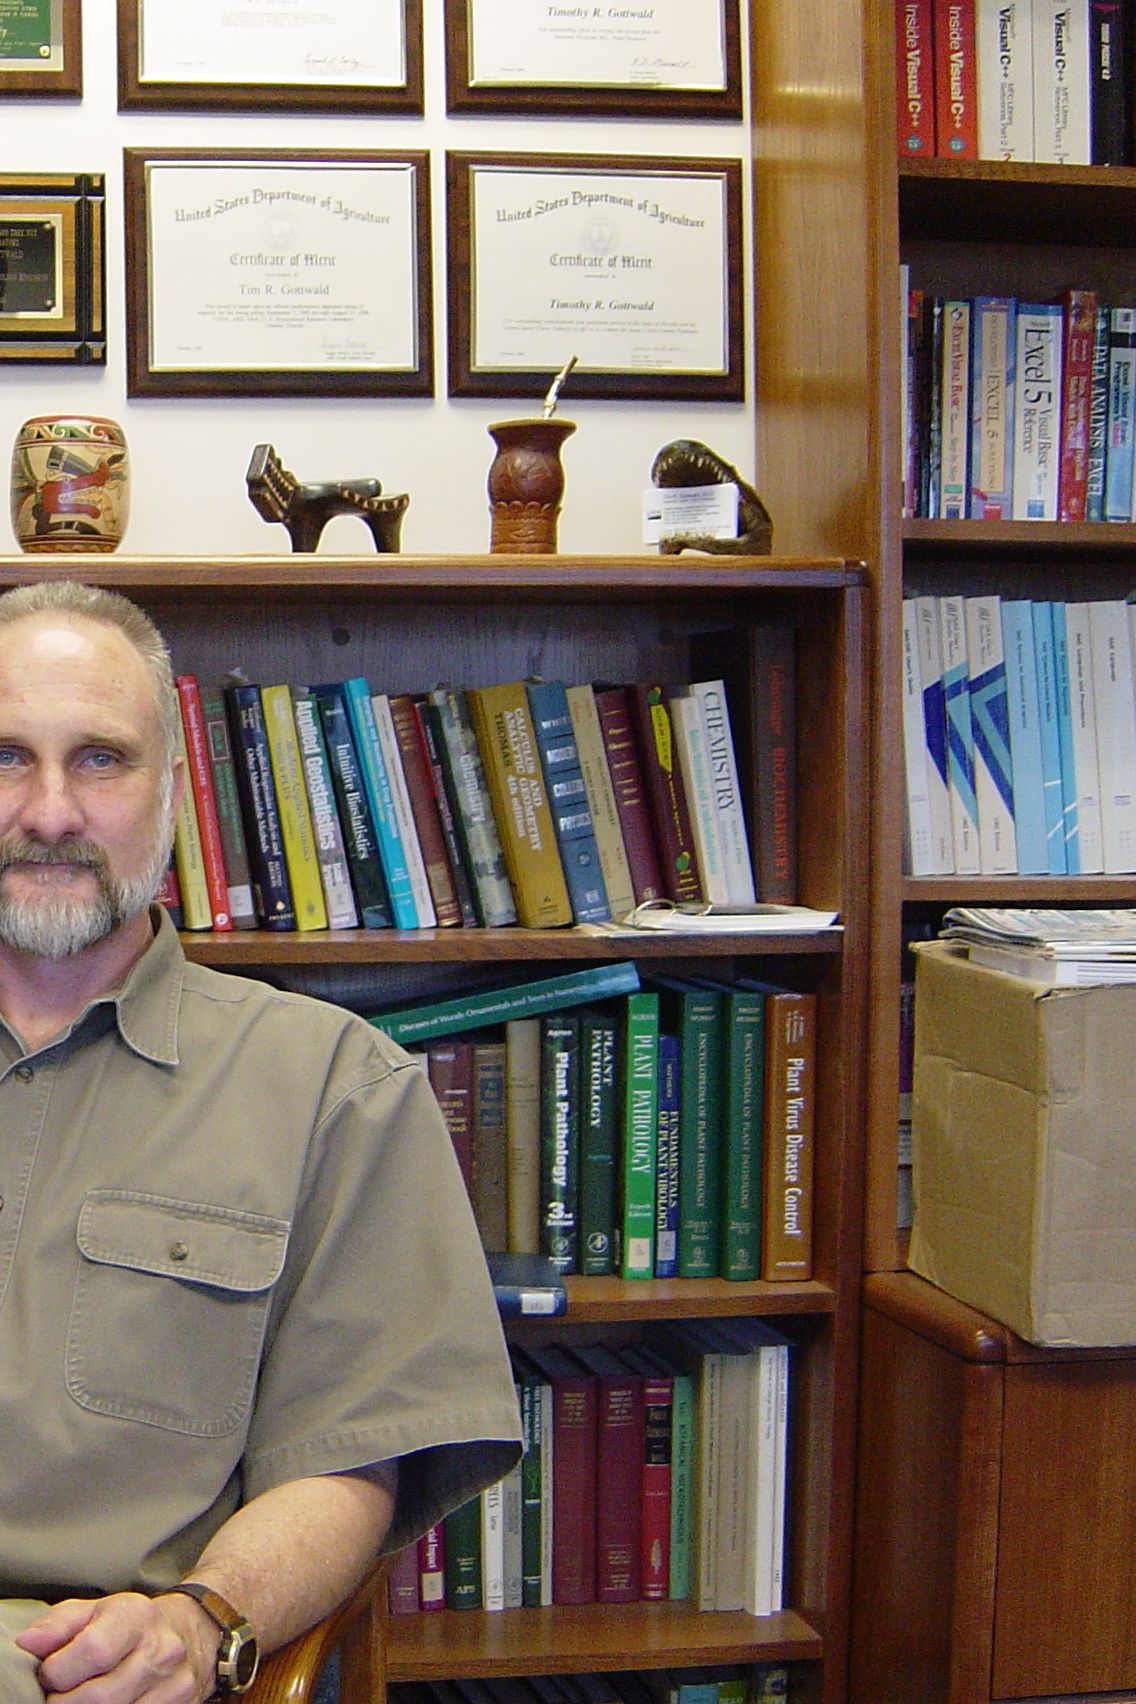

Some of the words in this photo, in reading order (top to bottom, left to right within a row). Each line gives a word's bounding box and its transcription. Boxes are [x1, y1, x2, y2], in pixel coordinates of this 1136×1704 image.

[546, 6, 588, 19] Timothy
[592, 6, 604, 19] R.
[607, 6, 654, 19] Gottwald
[905, 4, 920, 48] Inside
[949, 6, 964, 50] Inside
[999, 7, 1011, 52] Visual
[1055, 12, 1066, 55] Visual
[906, 49, 921, 99] Visual
[950, 51, 964, 102] Visual
[1000, 55, 1011, 79] C++
[1055, 58, 1066, 83] C++
[908, 101, 921, 127] C++
[951, 103, 964, 129] C++
[175, 207, 211, 222] United
[214, 196, 249, 215] States
[252, 188, 316, 205] Department
[320, 196, 332, 210] of
[333, 200, 391, 224] Agriculture
[496, 207, 531, 222] United
[535, 197, 569, 216] States
[571, 190, 634, 207] Department
[638, 200, 649, 213] of
[649, 203, 705, 228] Agriculture
[230, 253, 285, 267] Certificate
[290, 253, 300, 267] of
[304, 253, 336, 267] Merit
[549, 253, 604, 268] Certificate
[608, 255, 619, 268] of
[622, 255, 652, 269] Merit
[239, 284, 260, 296] Tim
[265, 284, 276, 296] R.
[281, 284, 329, 296] Gottwald
[549, 299, 591, 311] Timothy
[594, 299, 605, 311] R.
[608, 299, 654, 311] Gottwald
[1023, 328, 1052, 384] Excel
[1093, 345, 1107, 380] DATA
[986, 374, 1000, 426] EXCEL
[1024, 388, 1052, 404] 5
[1090, 384, 1105, 449] ANALYSIS
[1023, 407, 1037, 453] Reference
[1038, 407, 1052, 441] Visual
[1037, 442, 1051, 466] Basic
[1087, 457, 1104, 497] EXCEL
[295, 700, 320, 755] Applied
[255, 742, 268, 770] Applied
[514, 707, 537, 774] CALCULUS
[530, 778, 544, 807] AND
[703, 691, 735, 811] CHEMISTRY
[495, 712, 512, 767] THOMAS
[507, 774, 517, 795] 4th
[513, 798, 526, 838] edition
[504, 710, 525, 773] ANALYTIC
[519, 777, 541, 851] GEOMETRY
[306, 757, 336, 850] Geostatistics
[337, 743, 355, 791] Intuitive
[346, 792, 371, 860] Biostatistics
[547, 1029, 572, 1037] Agrios
[555, 1051, 570, 1096] Plant
[590, 1029, 602, 1128] PATHOLOGY
[603, 1030, 614, 1086] PLANT
[633, 1034, 653, 1079] PLANT
[697, 1032, 707, 1104] ENCYCLOPEDIA
[744, 1033, 753, 1104] ENCYCLOPEDIA
[786, 1057, 804, 1093] Plant
[631, 1089, 651, 1174] PATHOLOGY
[658, 1110, 668, 1129] OF
[698, 1105, 706, 1118] OF
[743, 1106, 752, 1118] OF
[786, 1097, 804, 1130] Virus
[552, 1101, 570, 1187] Pathology
[657, 1130, 668, 1168] PLANT
[698, 1120, 706, 1151] PLANT
[742, 1121, 752, 1152] PLANT
[668, 1110, 679, 1208] FUNDAMENTALS
[696, 1153, 706, 1208] PATHOLOGY
[785, 1134, 804, 1183] Disease
[657, 1168, 668, 1231] VIROLOGY
[740, 1153, 751, 1209] PATHOLOGY
[783, 1187, 803, 1236] Control
